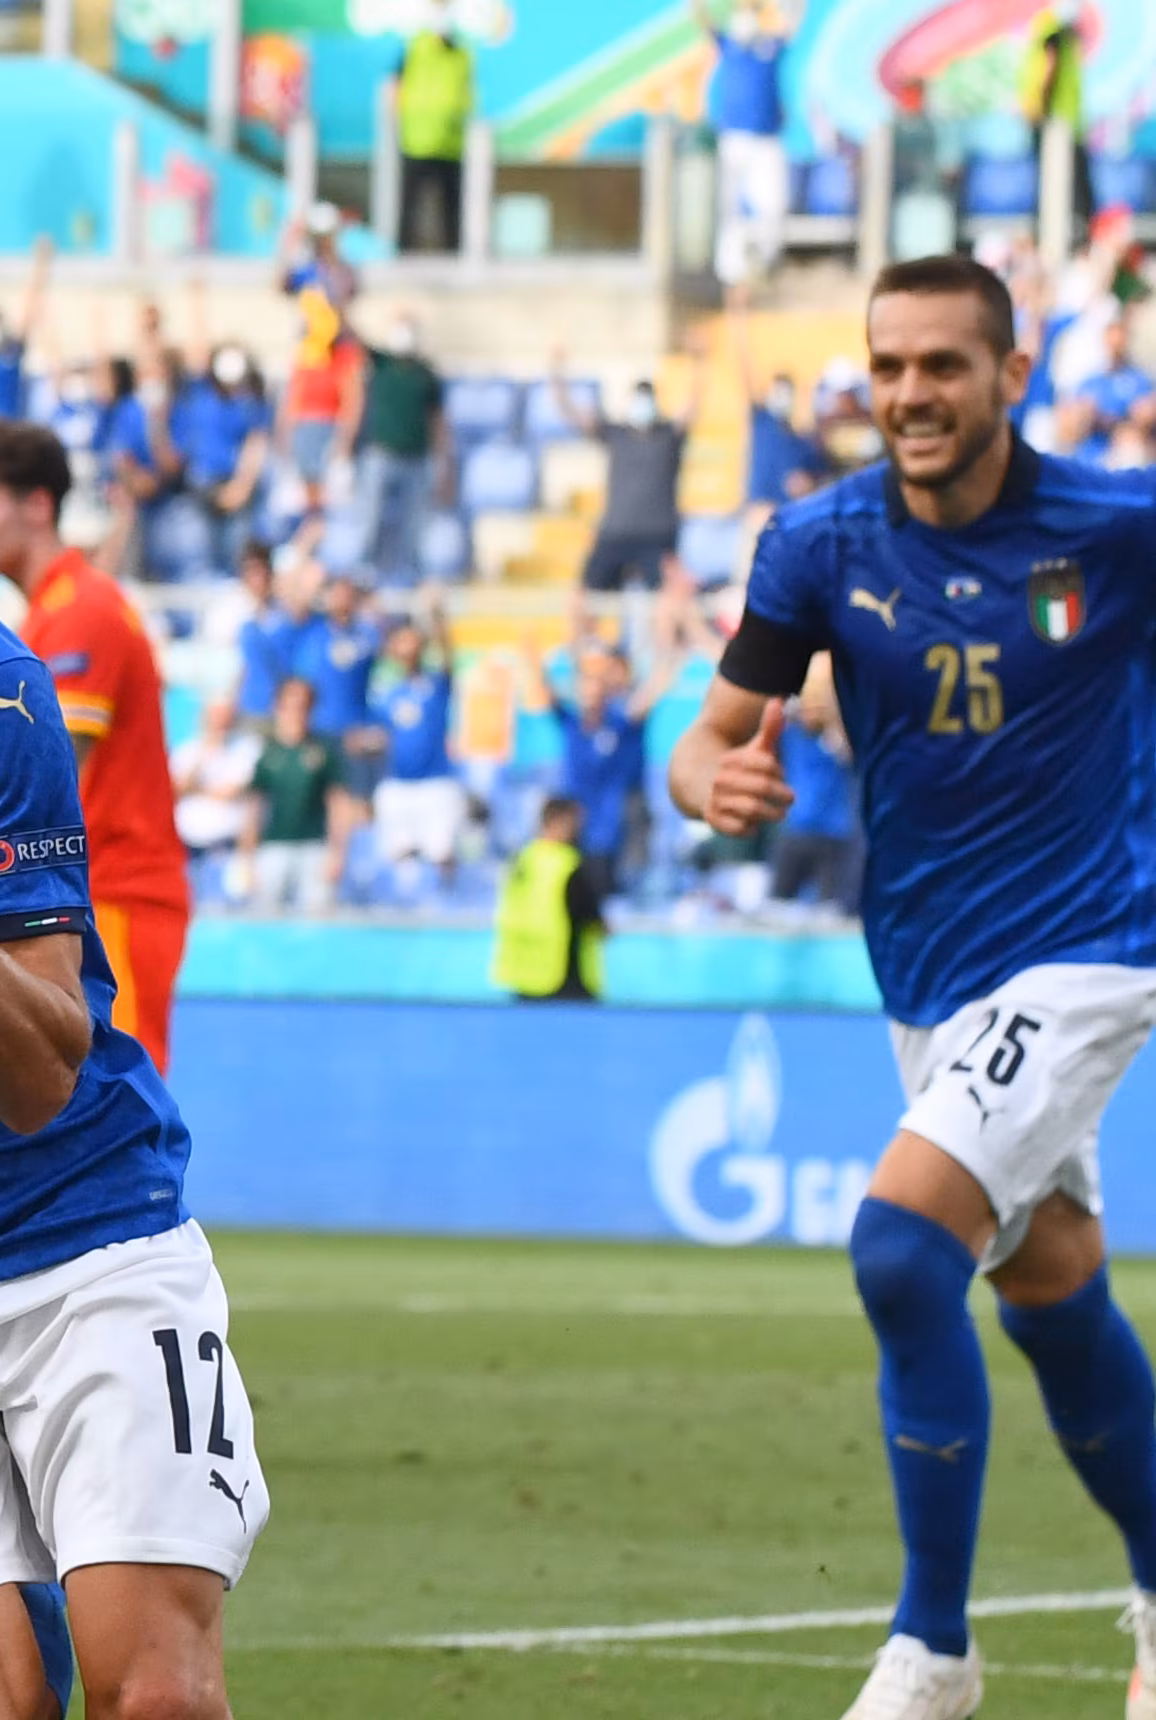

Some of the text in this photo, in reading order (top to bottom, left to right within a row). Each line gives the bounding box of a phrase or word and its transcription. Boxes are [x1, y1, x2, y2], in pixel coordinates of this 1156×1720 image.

[925, 642, 1003, 734] 25
[17, 835, 86, 861] RESPECT
[949, 1007, 1042, 1087] 25
[152, 1328, 234, 1460] 12
